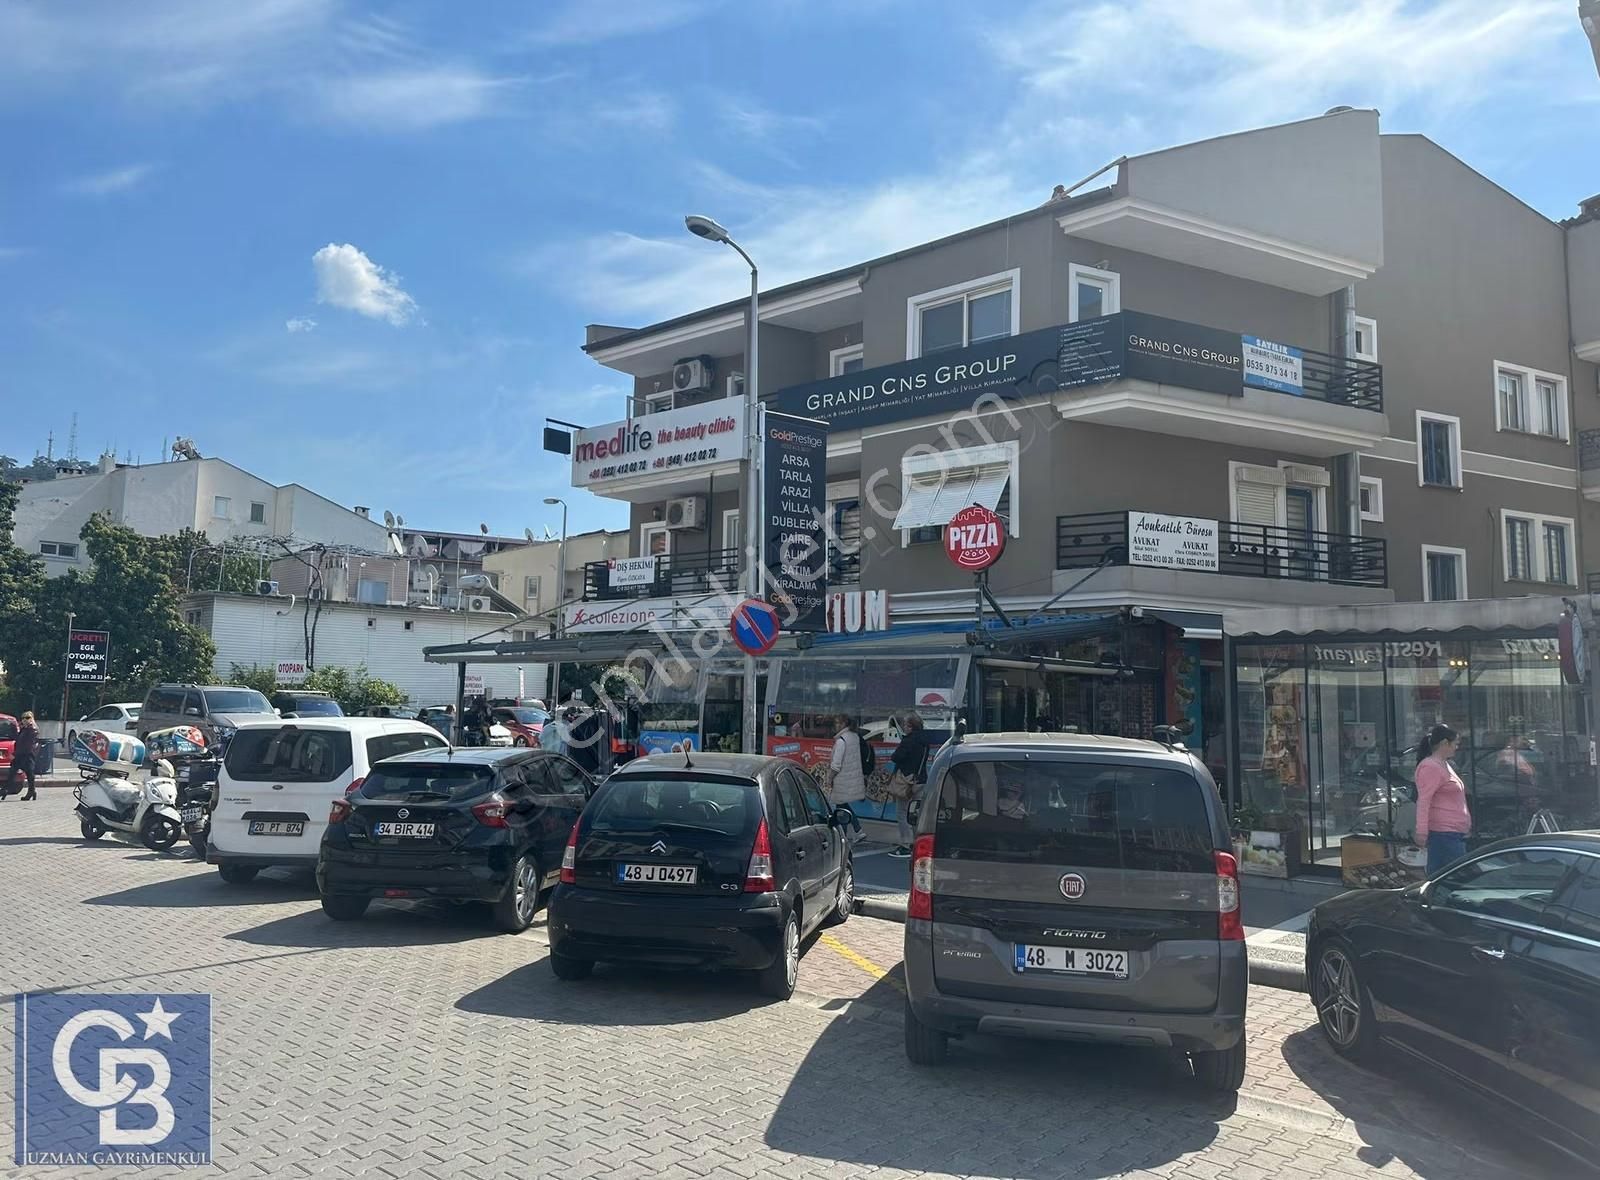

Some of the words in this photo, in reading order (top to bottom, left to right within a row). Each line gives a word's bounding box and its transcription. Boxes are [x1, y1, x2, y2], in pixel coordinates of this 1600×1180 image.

[1129, 335, 1170, 352] GRAND
[1201, 350, 1240, 365] GROUP
[1246, 359, 1263, 371] 0535
[806, 385, 875, 411] GRAND
[935, 354, 1017, 384] GROUP
[575, 418, 653, 462] medlife
[657, 429, 672, 444] the
[674, 422, 707, 440] beauty
[708, 415, 736, 434] clinic
[770, 428, 823, 448] GoldPrestige
[782, 454, 810, 468] ARSA
[780, 469, 812, 483] TARLA
[781, 486, 811, 499] ARAZİ
[782, 500, 811, 514] VİLLA
[772, 515, 819, 530] DUBLEKS
[1136, 516, 1182, 535] Avukatlık
[780, 531, 811, 546] DAİRE
[1132, 536, 1160, 547] AVUKAT
[1182, 541, 1209, 552] AVUKAT
[68, 653, 105, 661] OTOPARK
[278, 663, 305, 673] OTOPARK
[255, 823, 264, 832] 20
[270, 823, 280, 832] PT
[380, 824, 390, 834] 34
[394, 824, 413, 835] BIR
[417, 824, 432, 835] 414
[625, 867, 641, 880] 48
[646, 868, 655, 880] J
[659, 868, 694, 882] 0497
[1066, 881, 1080, 893] FIAT
[1027, 948, 1045, 966] 48
[1065, 950, 1075, 968] M
[1085, 952, 1124, 972] 3022
